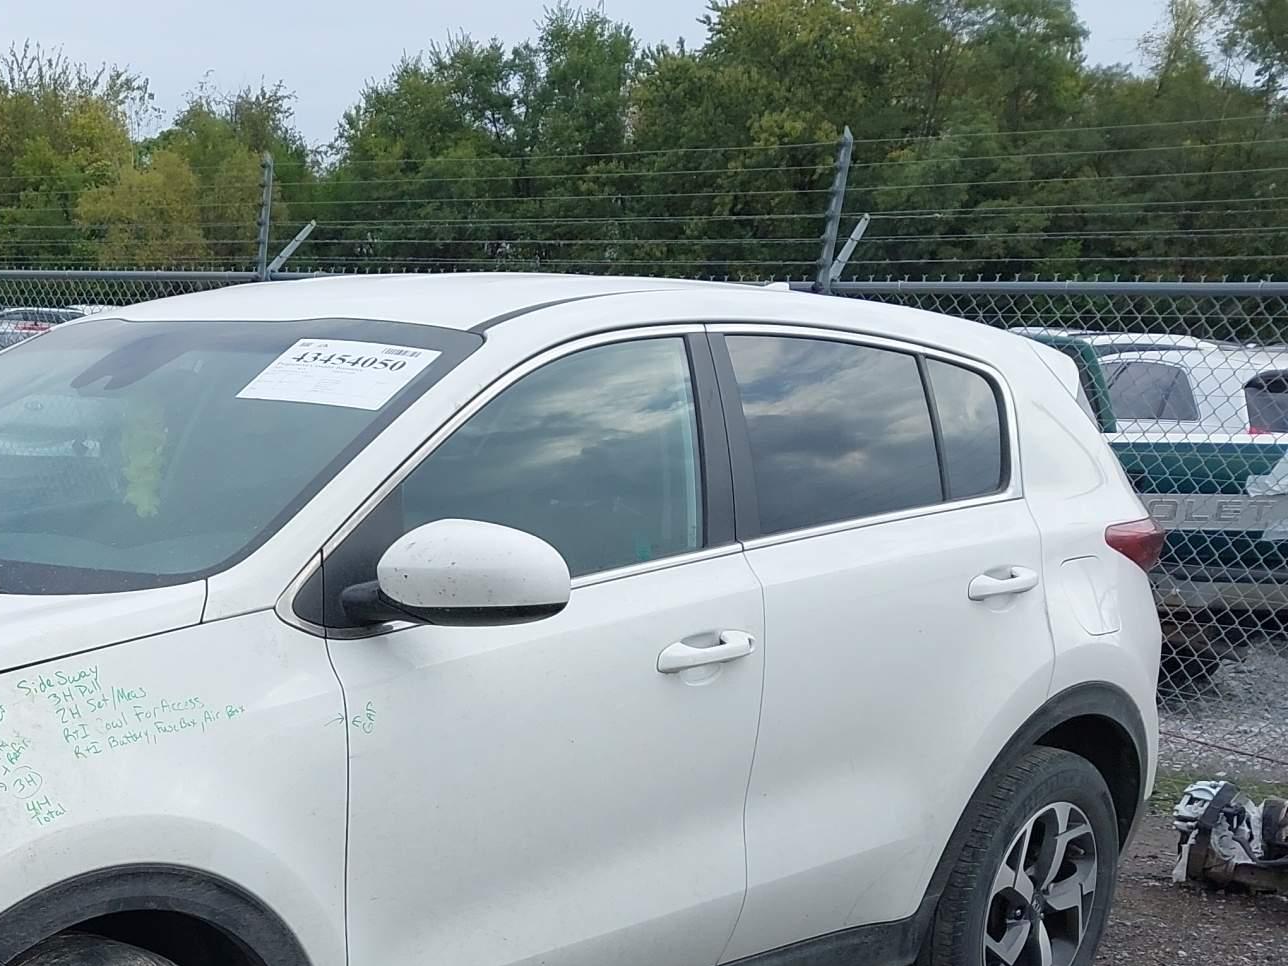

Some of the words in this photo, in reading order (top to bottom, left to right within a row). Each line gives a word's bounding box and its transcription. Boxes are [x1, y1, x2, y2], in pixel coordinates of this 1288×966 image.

[292, 351, 407, 371] 43454050
[16, 675, 54, 696] Side
[55, 665, 98, 686] Sway
